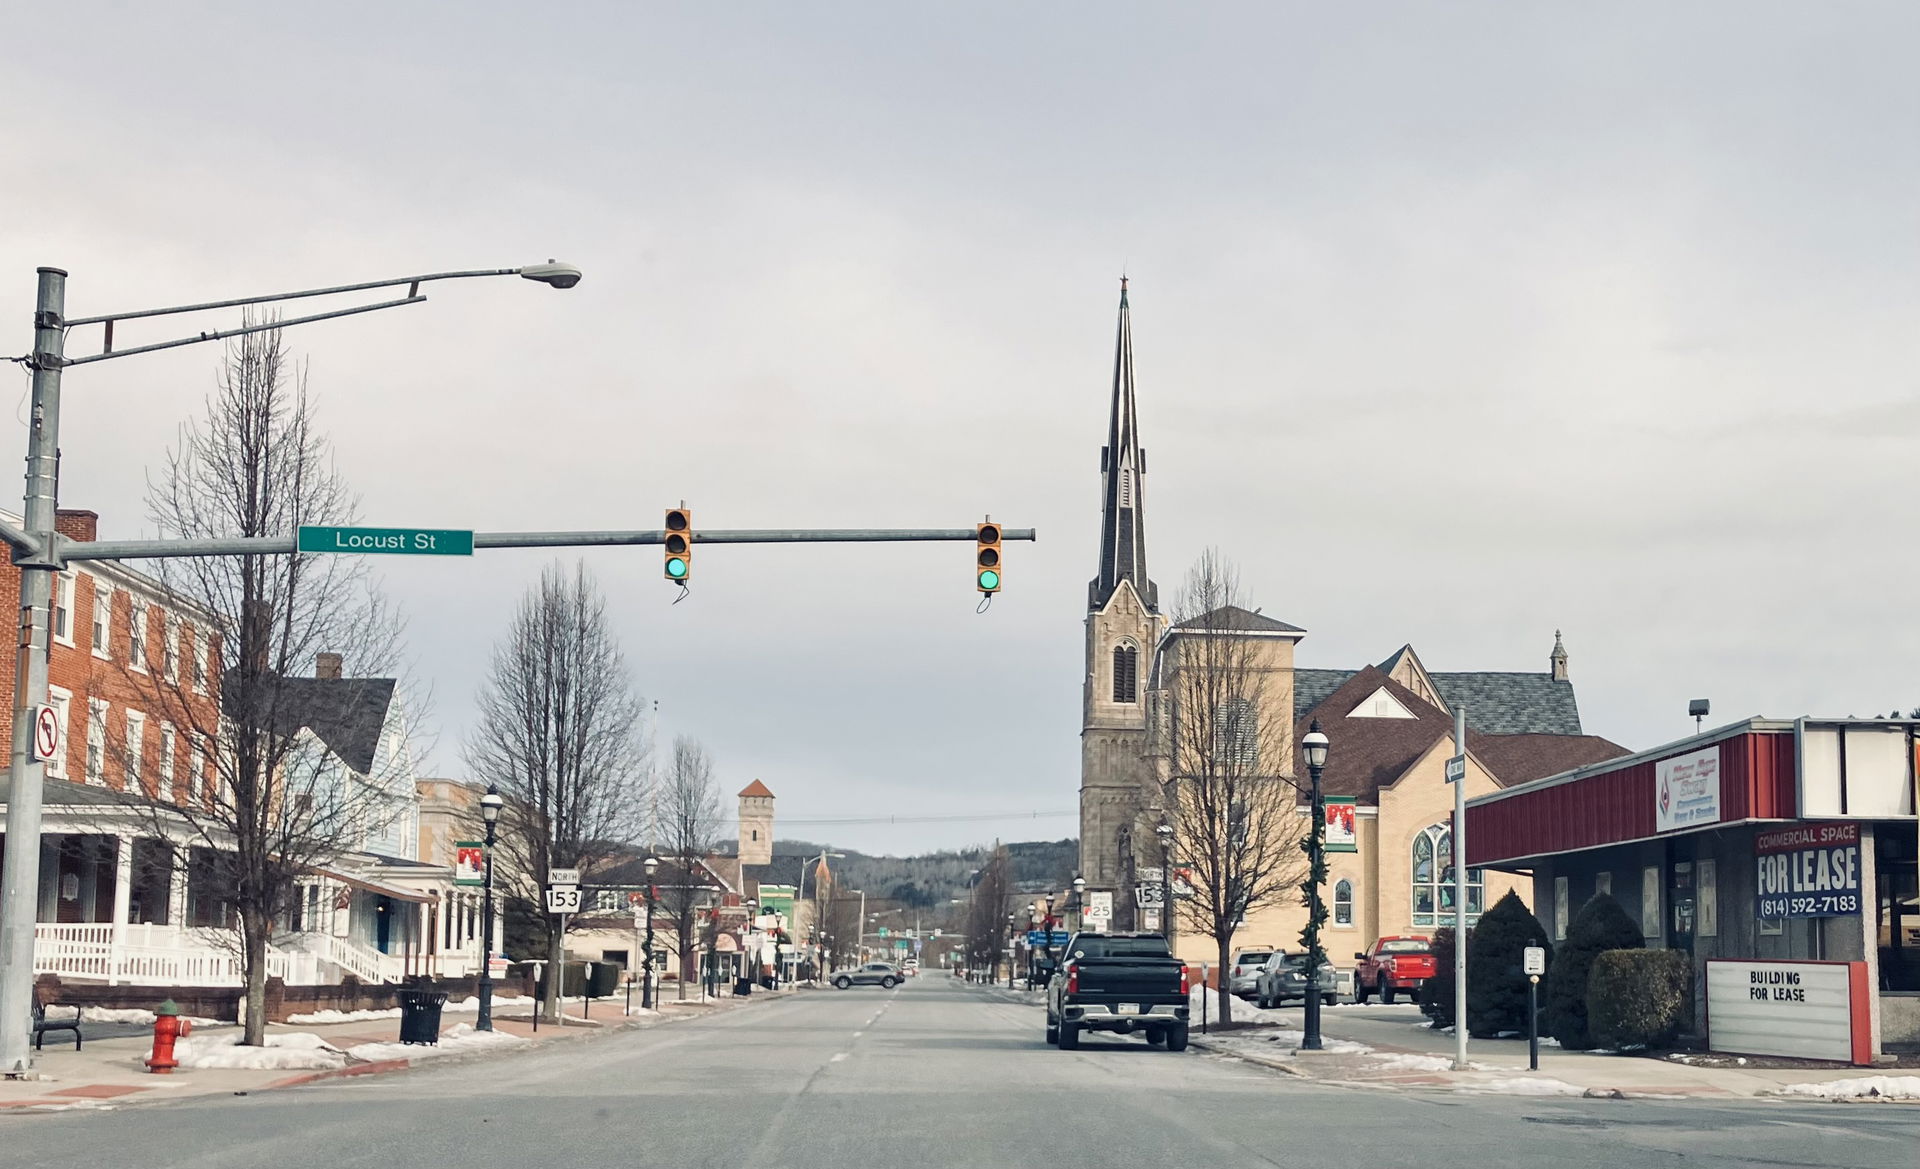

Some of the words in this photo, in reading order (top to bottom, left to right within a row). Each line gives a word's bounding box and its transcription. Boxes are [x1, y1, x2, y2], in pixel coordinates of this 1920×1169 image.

[336, 531, 405, 549] Locust
[414, 533, 436, 550] St
[1758, 829, 1817, 849] COMMERCIAL
[1820, 825, 1856, 842] SPACE
[551, 871, 578, 881] NORTH
[1757, 854, 1789, 896] FOR
[1792, 847, 1857, 893] LEASE
[549, 891, 578, 907] 153
[1138, 888, 1164, 903] 153
[1092, 906, 1110, 917] 25
[1761, 898, 1789, 918] (814)
[1791, 895, 1857, 914] 592-7183
[1750, 971, 1801, 985] BUILDING
[1750, 987, 1768, 1000] FOR
[1773, 987, 1805, 1002] LEASE
